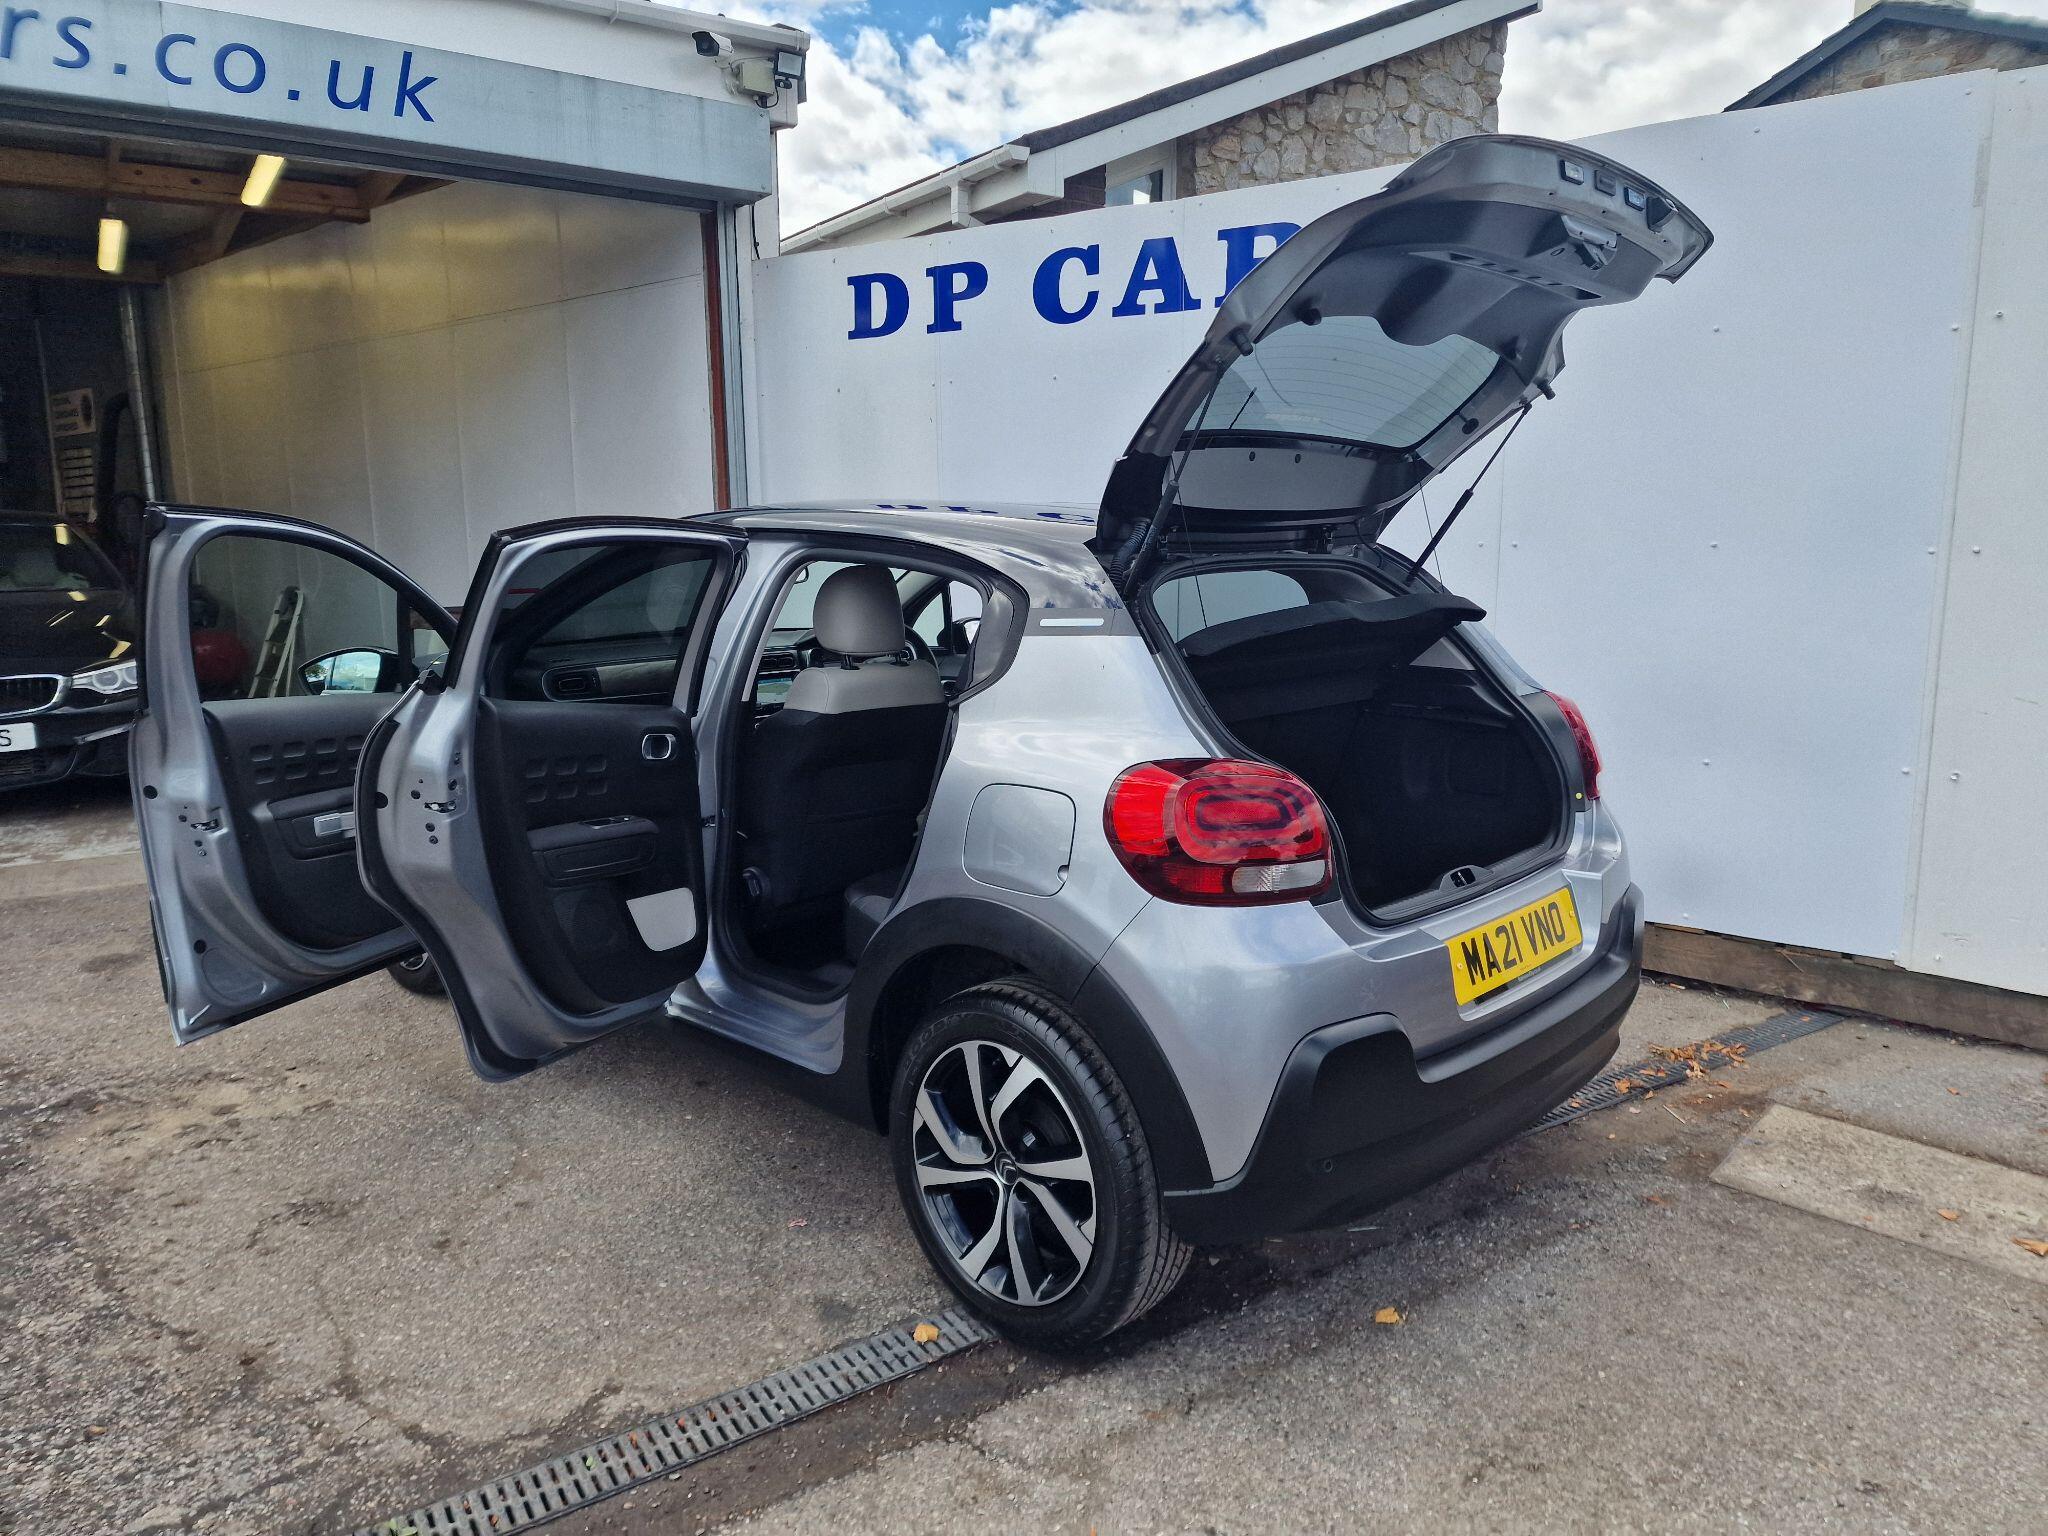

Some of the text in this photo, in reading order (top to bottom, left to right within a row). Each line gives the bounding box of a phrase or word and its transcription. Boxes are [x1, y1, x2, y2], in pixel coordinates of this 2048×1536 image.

[848, 261, 989, 340] DP
[1461, 901, 1566, 986] MA21 VNO
